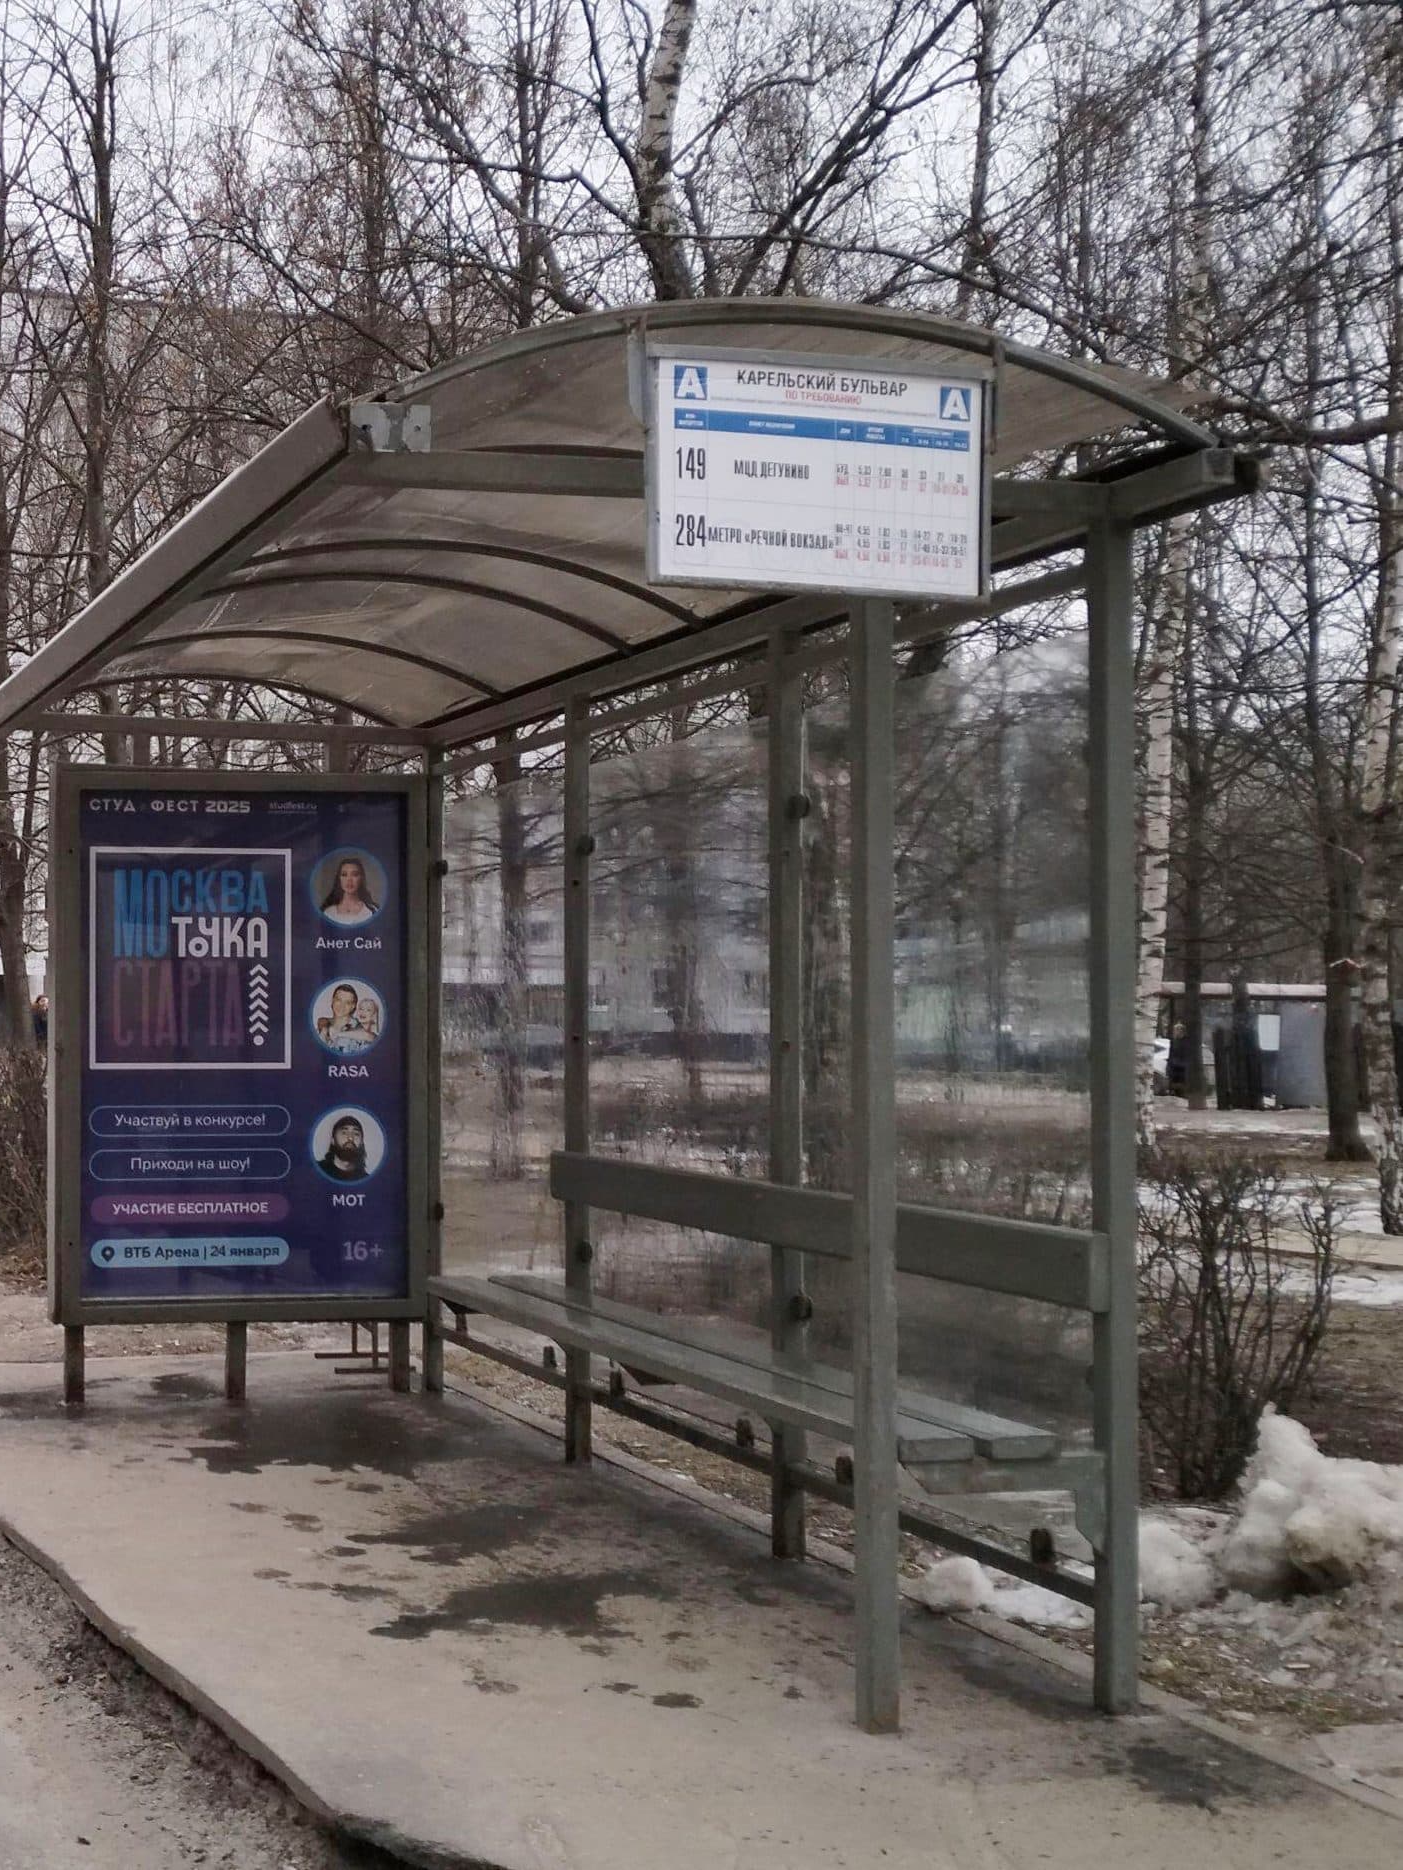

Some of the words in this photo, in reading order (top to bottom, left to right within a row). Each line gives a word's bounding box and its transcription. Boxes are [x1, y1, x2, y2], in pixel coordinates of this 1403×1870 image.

[737, 369, 836, 391] КАРЕЛЬСКИЙ
[840, 377, 908, 397] БУЛЬВАР
[785, 390, 798, 400] ПО
[801, 391, 862, 405] ТРЕБОВАНИЮ
[676, 447, 706, 480] 149
[734, 459, 758, 479] МЦД
[760, 461, 810, 480] ДЕГУНИНО
[676, 514, 706, 547] 284
[708, 527, 741, 543] МЕТРО
[745, 529, 787, 547] «РЕЧНОЙ
[89, 799, 136, 812] СТУД
[150, 800, 199, 813] ФЕСТ
[205, 801, 251, 814] 2025
[315, 937, 350, 950] Анет
[354, 936, 382, 950] Сай
[111, 960, 246, 1047] СТАРТА
[328, 1065, 369, 1078] RASA
[114, 1113, 180, 1128] Участвуй
[183, 1116, 192, 1127] в
[195, 1113, 266, 1128] конкурсе!
[130, 1157, 194, 1172] Приходи
[198, 1158, 215, 1169] на
[218, 1156, 251, 1172] шоу!
[332, 1194, 366, 1207] МОТ
[112, 1203, 175, 1216] УЧАСТИЕ
[178, 1202, 269, 1215] БЕСПЛАТНОЕ
[124, 1246, 151, 1259] ВТБ
[154, 1246, 200, 1261] Арена
[210, 1246, 226, 1257] 24
[230, 1246, 280, 1260] января
[342, 1240, 383, 1261] 16+
